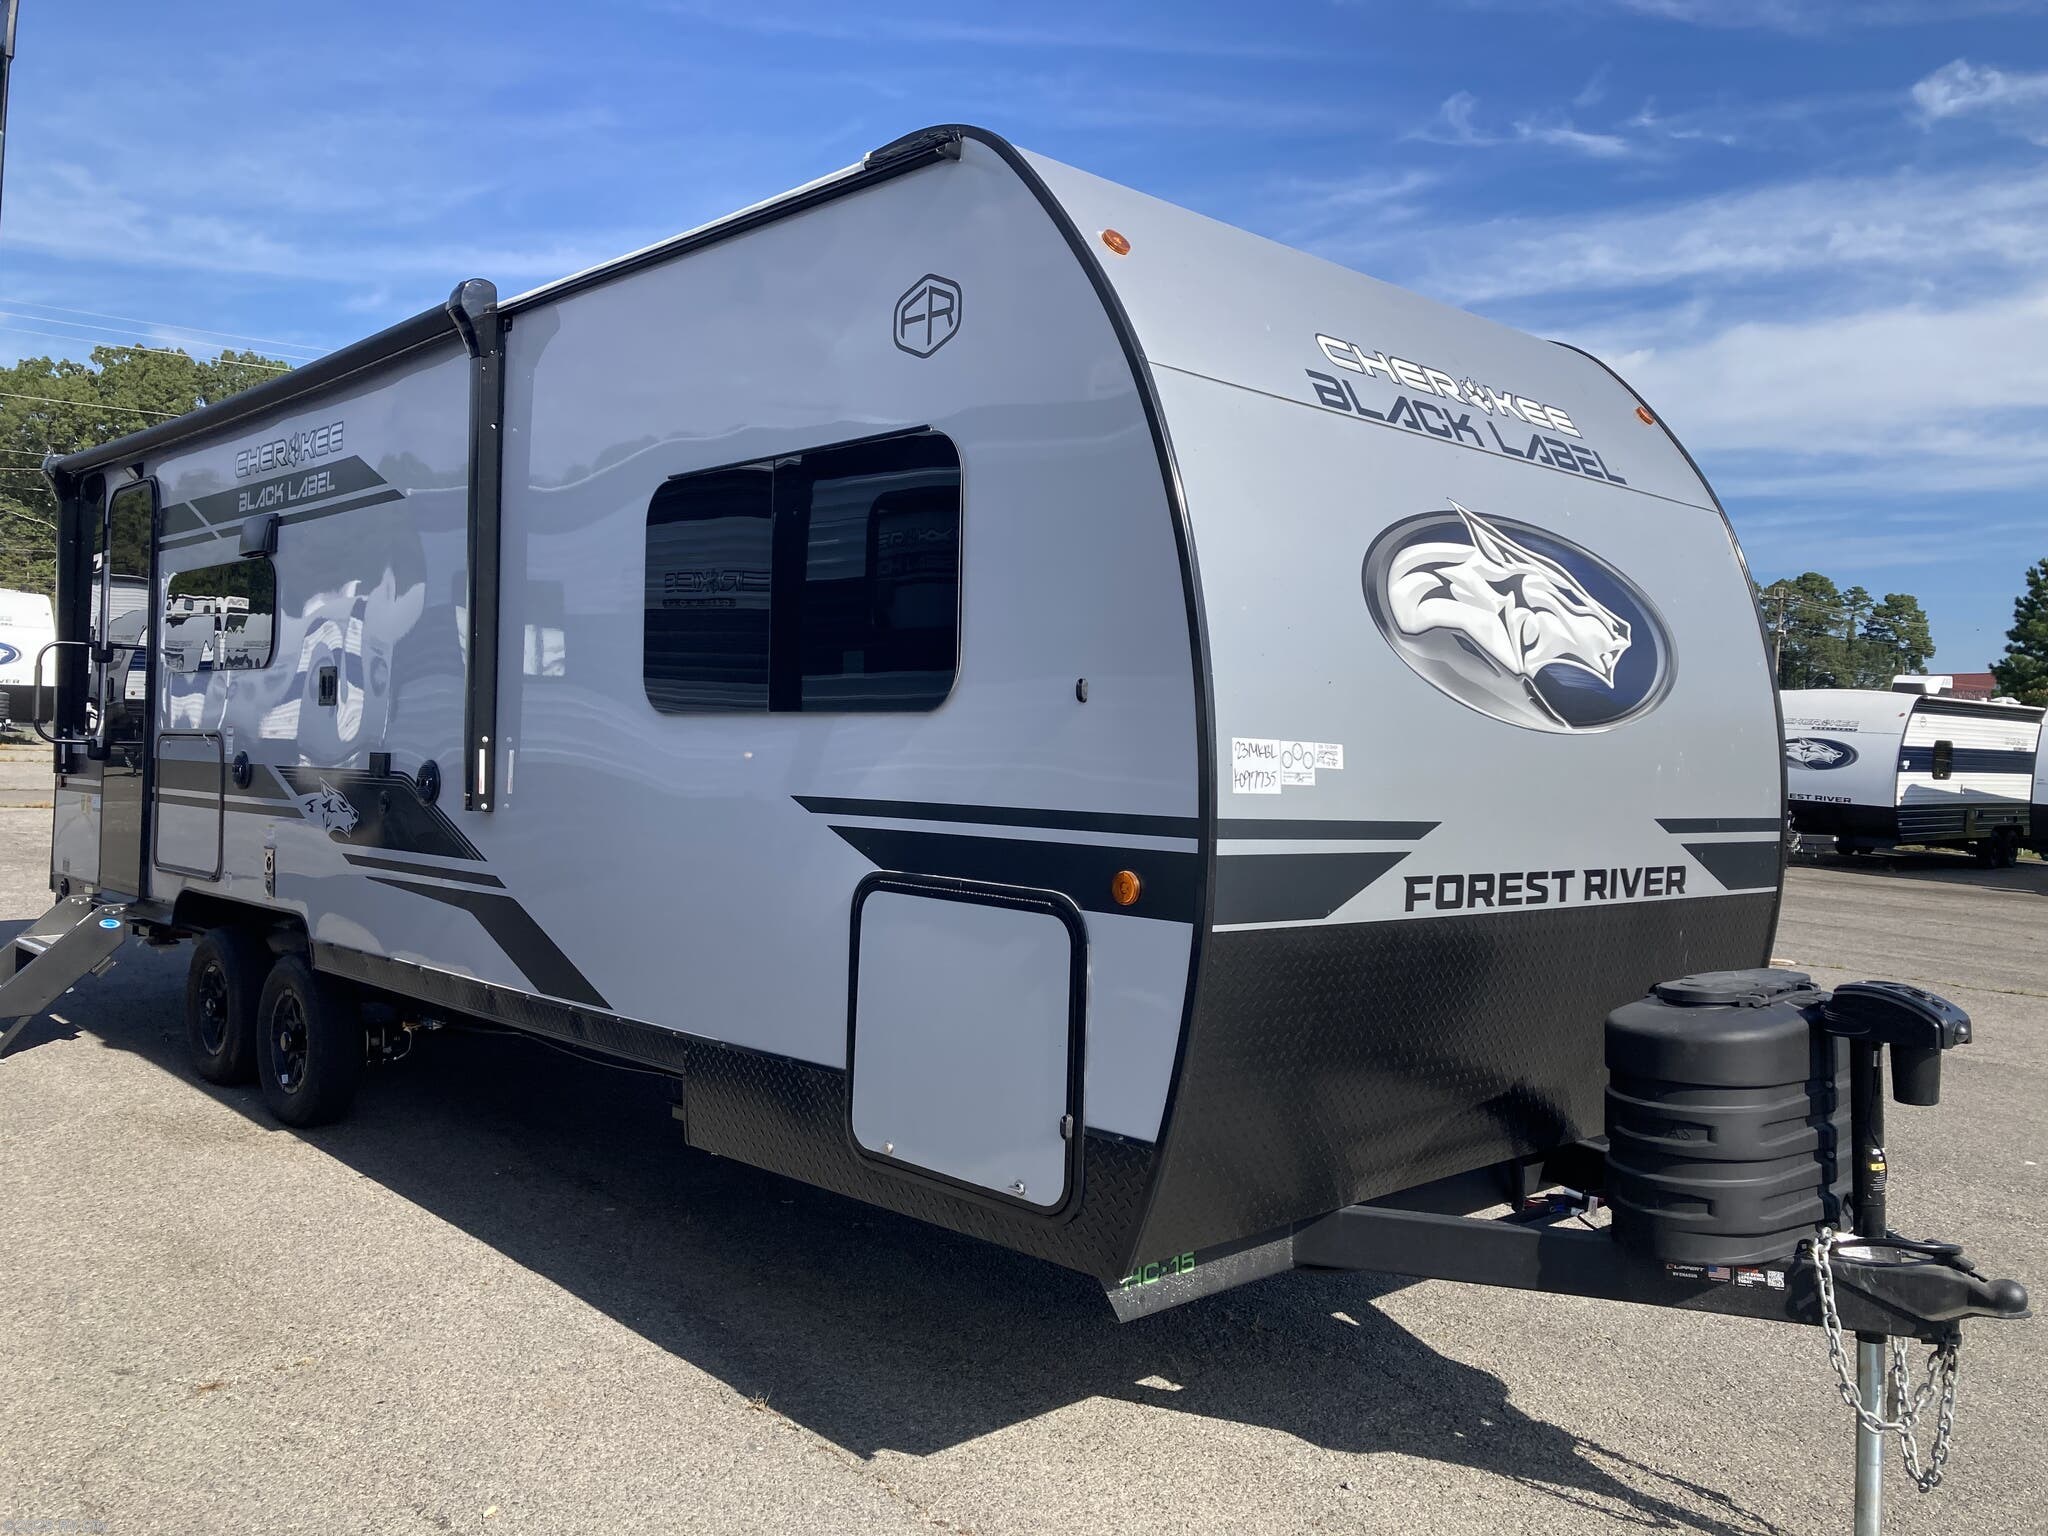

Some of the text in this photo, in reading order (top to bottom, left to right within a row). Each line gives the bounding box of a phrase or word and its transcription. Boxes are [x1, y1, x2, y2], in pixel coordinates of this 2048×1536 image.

[1305, 368, 1628, 485] BLACK LABEL
[239, 470, 336, 512] BLACK LABEL
[1814, 795, 1852, 803] RIVER
[1404, 865, 1687, 912] FOREST RIVER
